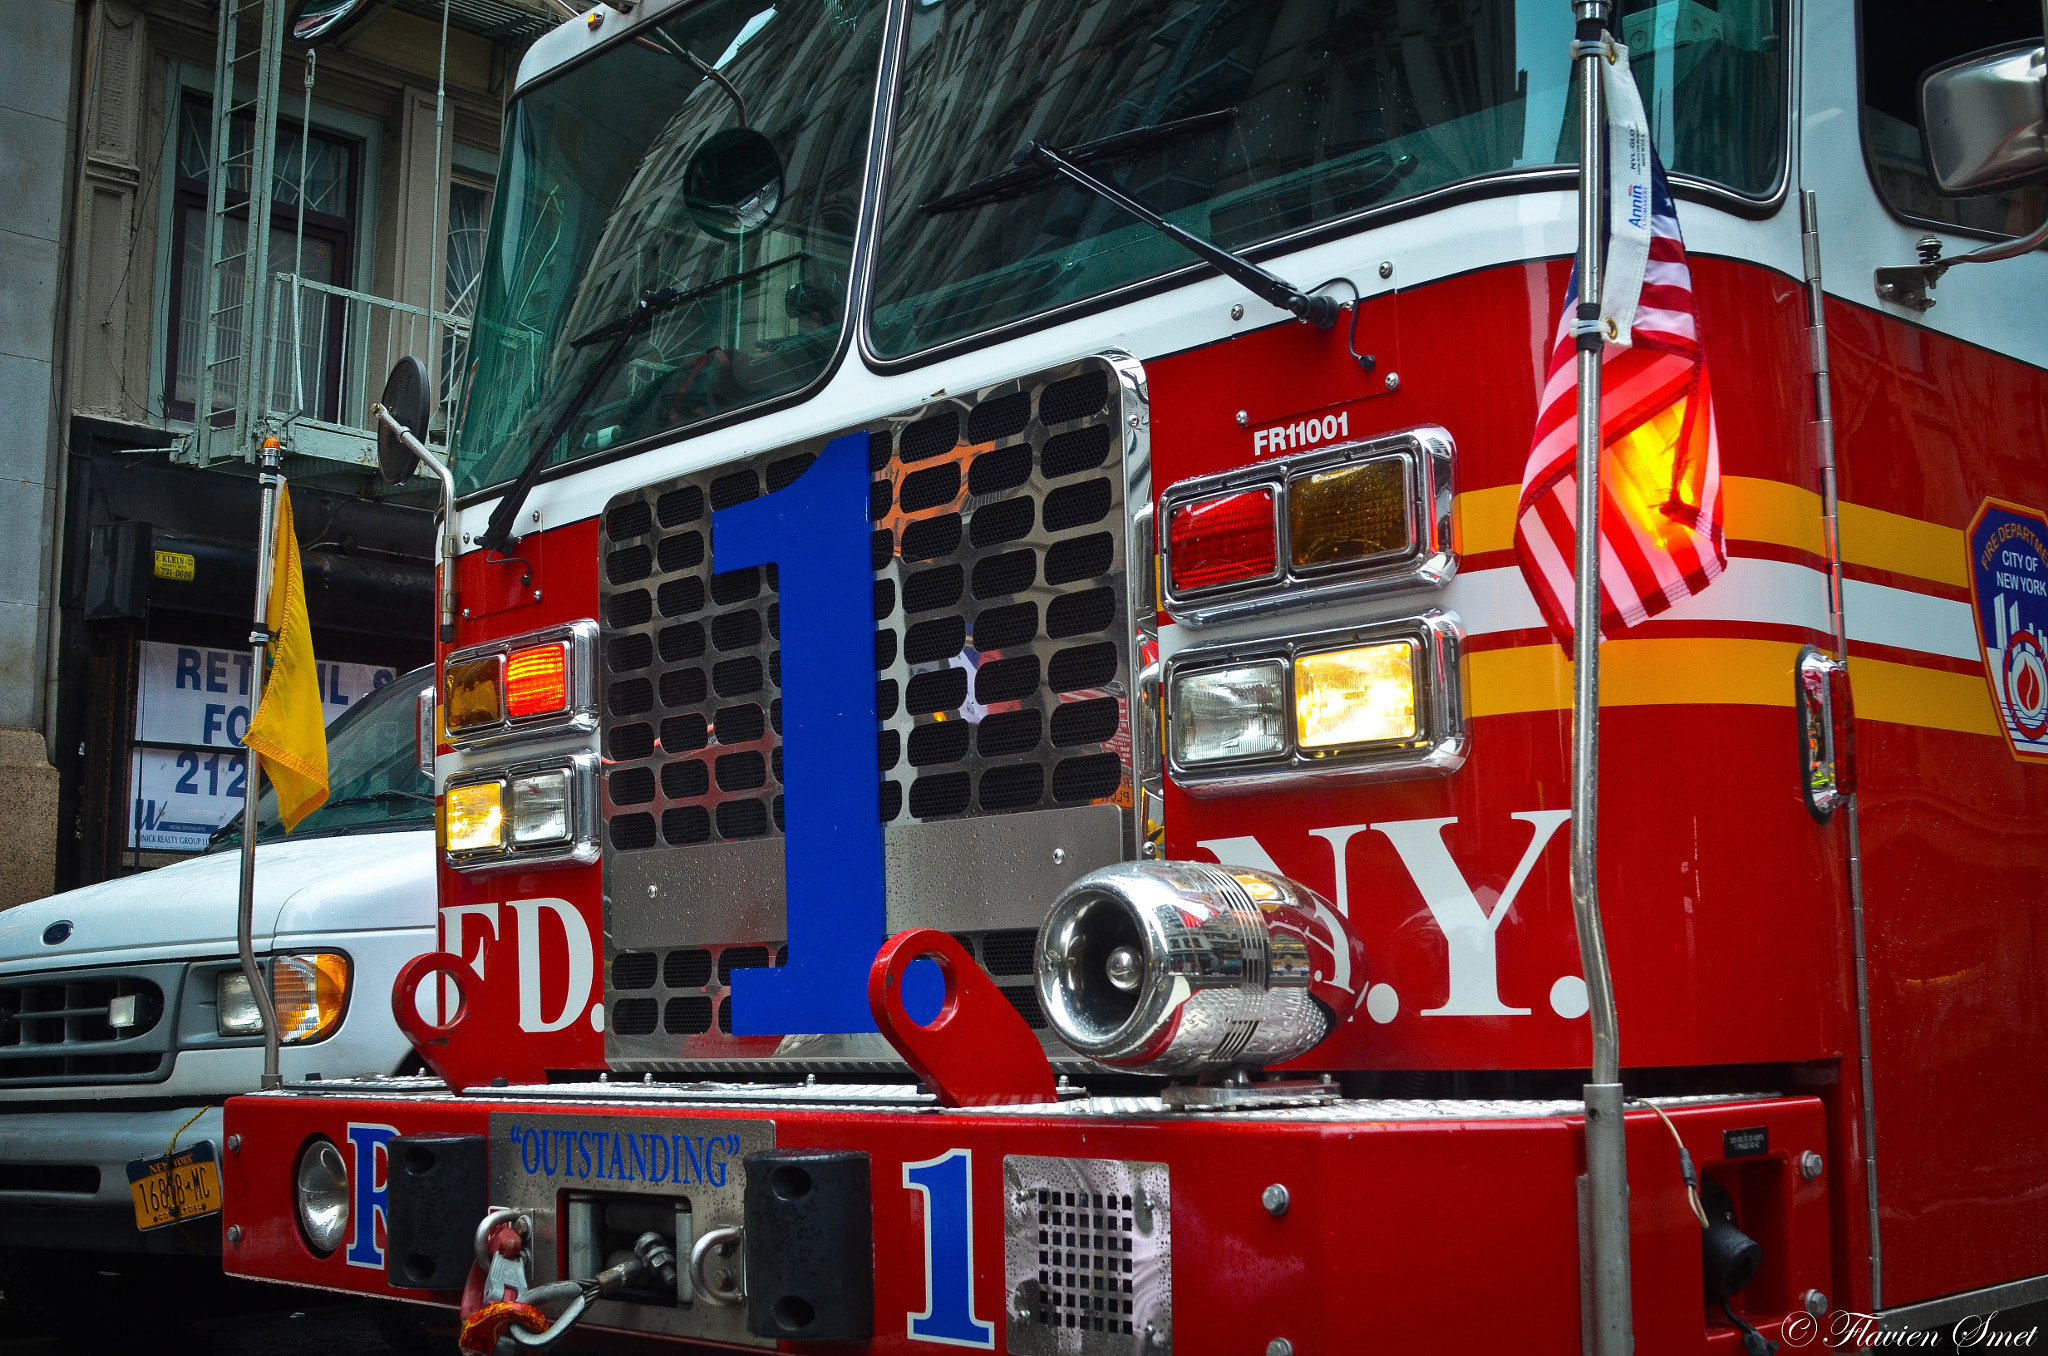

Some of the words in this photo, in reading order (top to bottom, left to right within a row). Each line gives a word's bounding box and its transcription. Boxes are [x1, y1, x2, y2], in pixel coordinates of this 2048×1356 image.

[1628, 184, 1642, 228] Annin
[1254, 411, 1349, 456] FR11001
[162, 555, 184, 565] KLEIN
[1981, 532, 2000, 571] FIRE
[2002, 550, 2023, 569] CITY
[2025, 555, 2038, 572] OF
[1996, 571, 2019, 590] NEW
[2020, 576, 2047, 597] YORK
[176, 647, 348, 706] RETIL
[713, 430, 945, 1036] 1
[157, 835, 178, 844] REALTY
[179, 836, 202, 845] GROUP
[173, 1154, 194, 1168] YORK
[902, 1148, 995, 1350] 1
